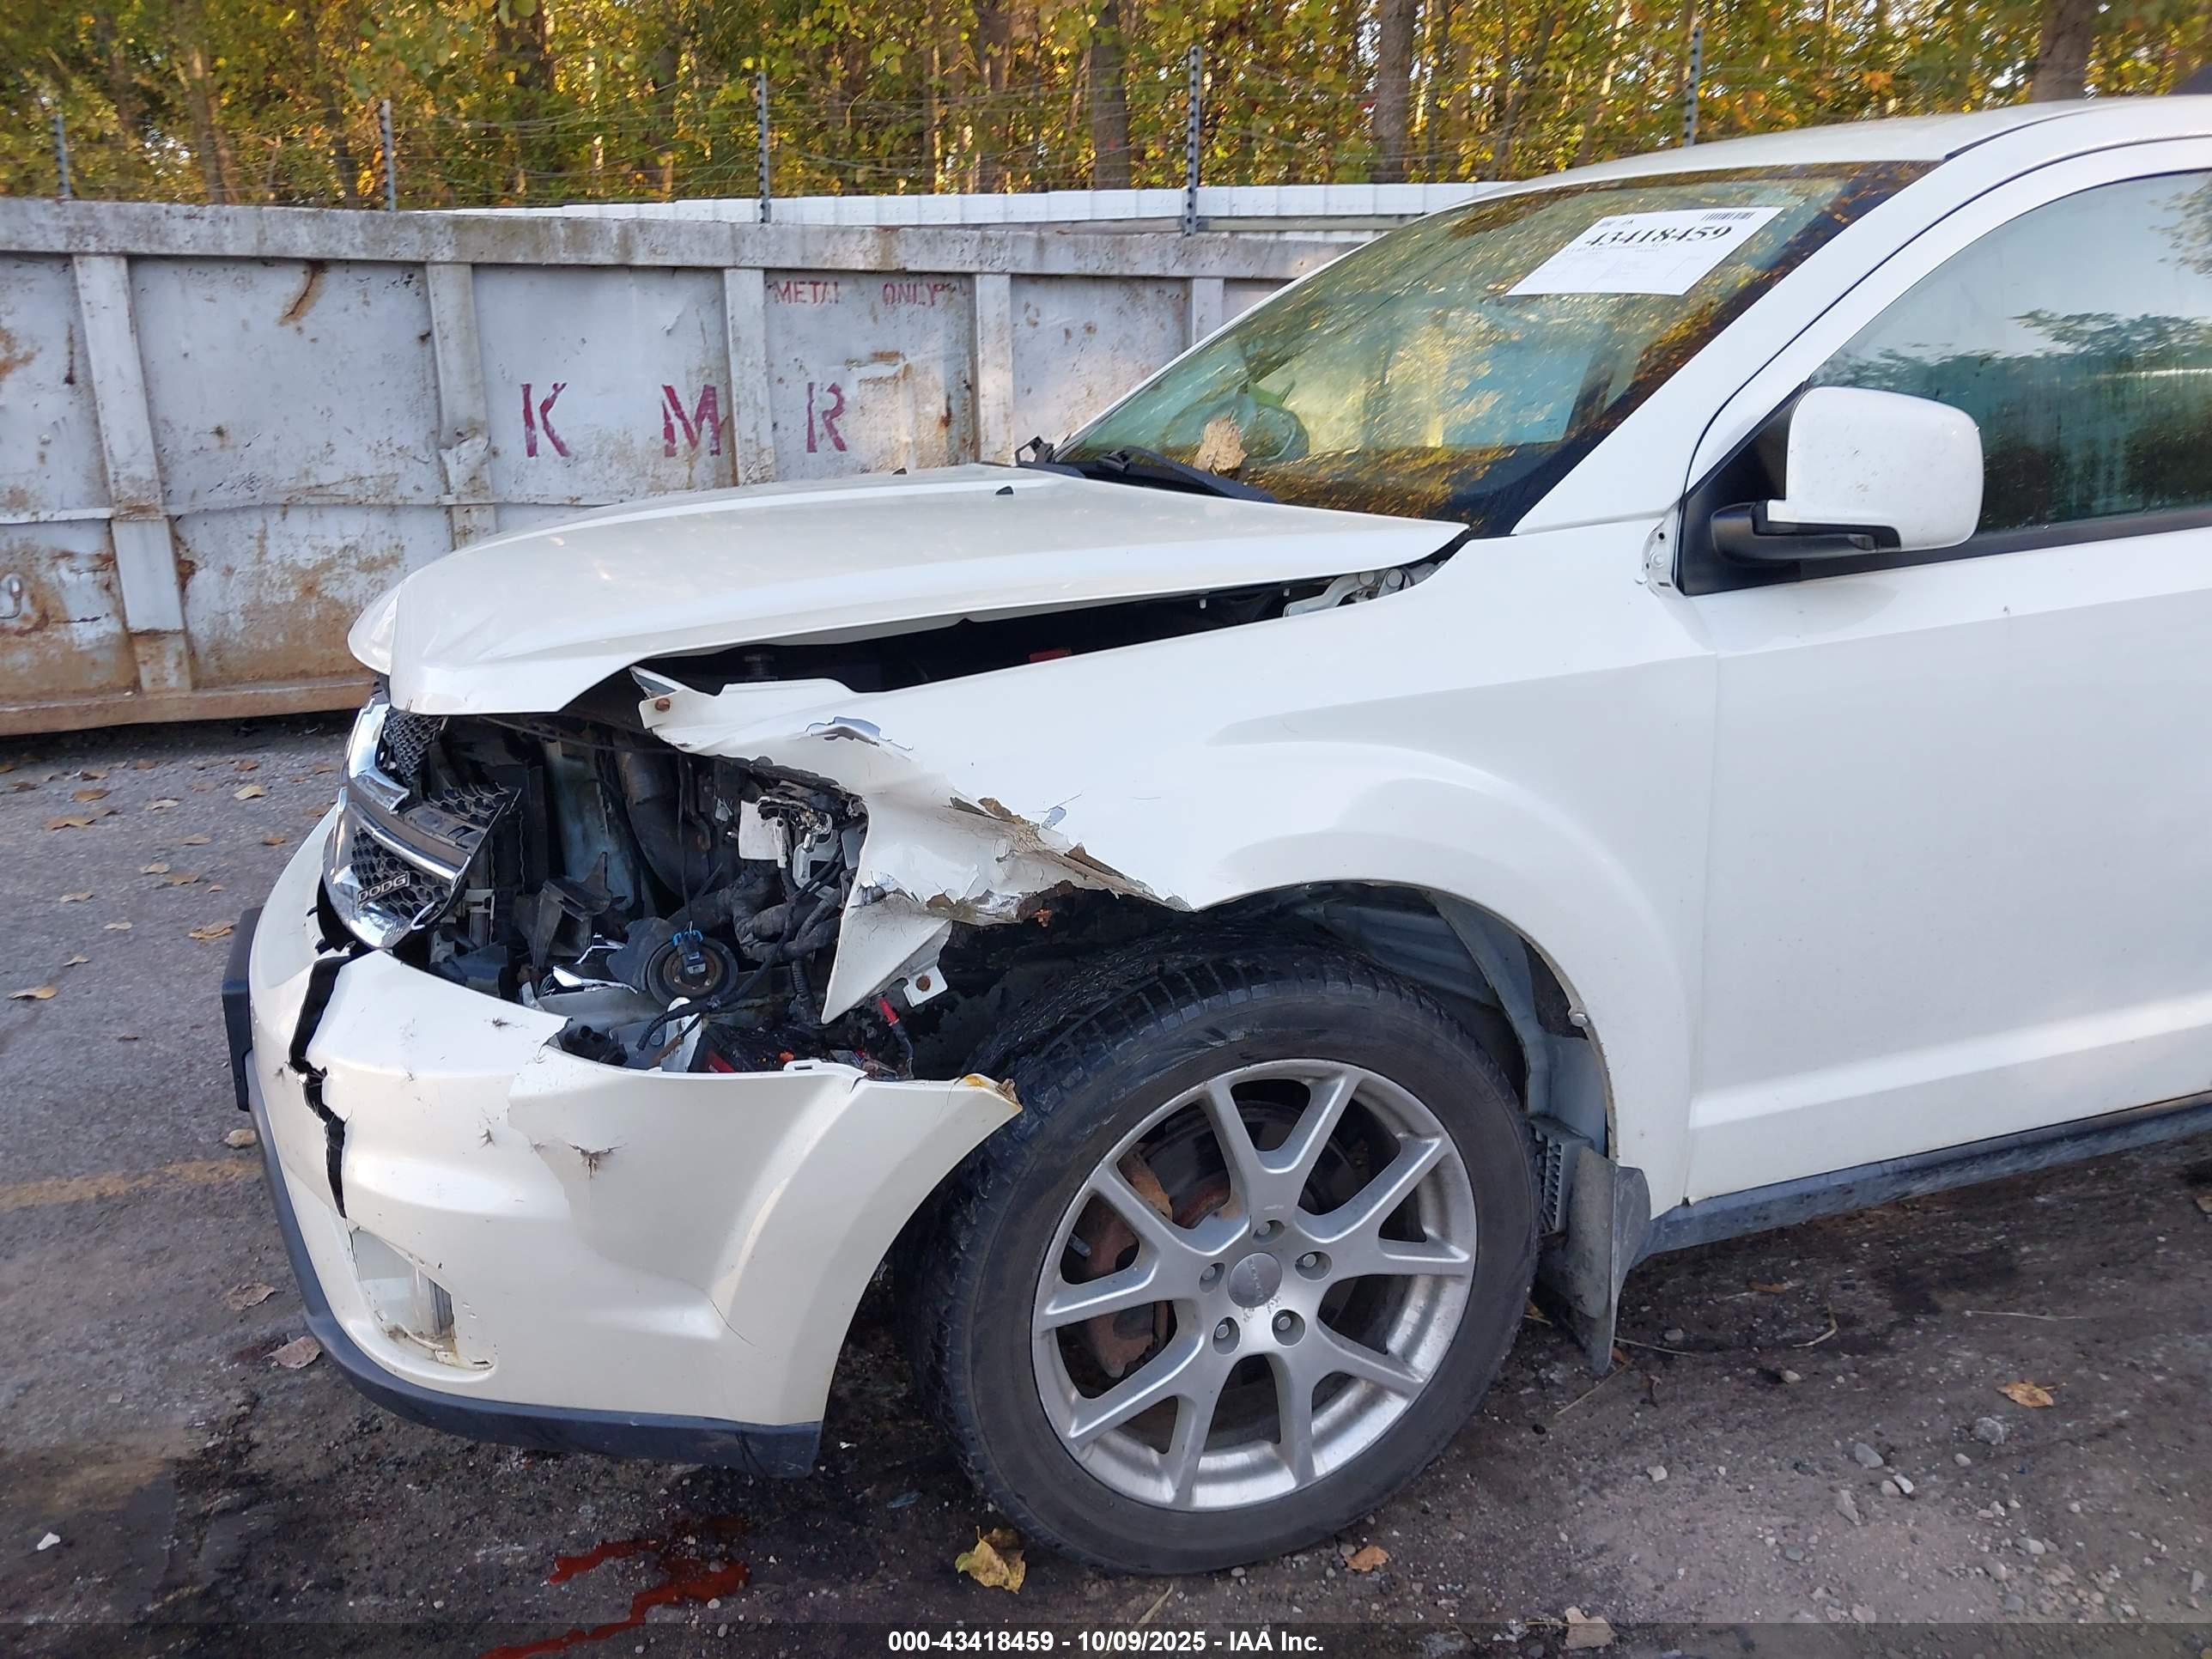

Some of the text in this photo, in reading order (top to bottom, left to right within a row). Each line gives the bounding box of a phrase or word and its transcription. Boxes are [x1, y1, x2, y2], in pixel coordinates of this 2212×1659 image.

[1587, 225, 1733, 246] 43418459
[520, 381, 848, 458] K M R
